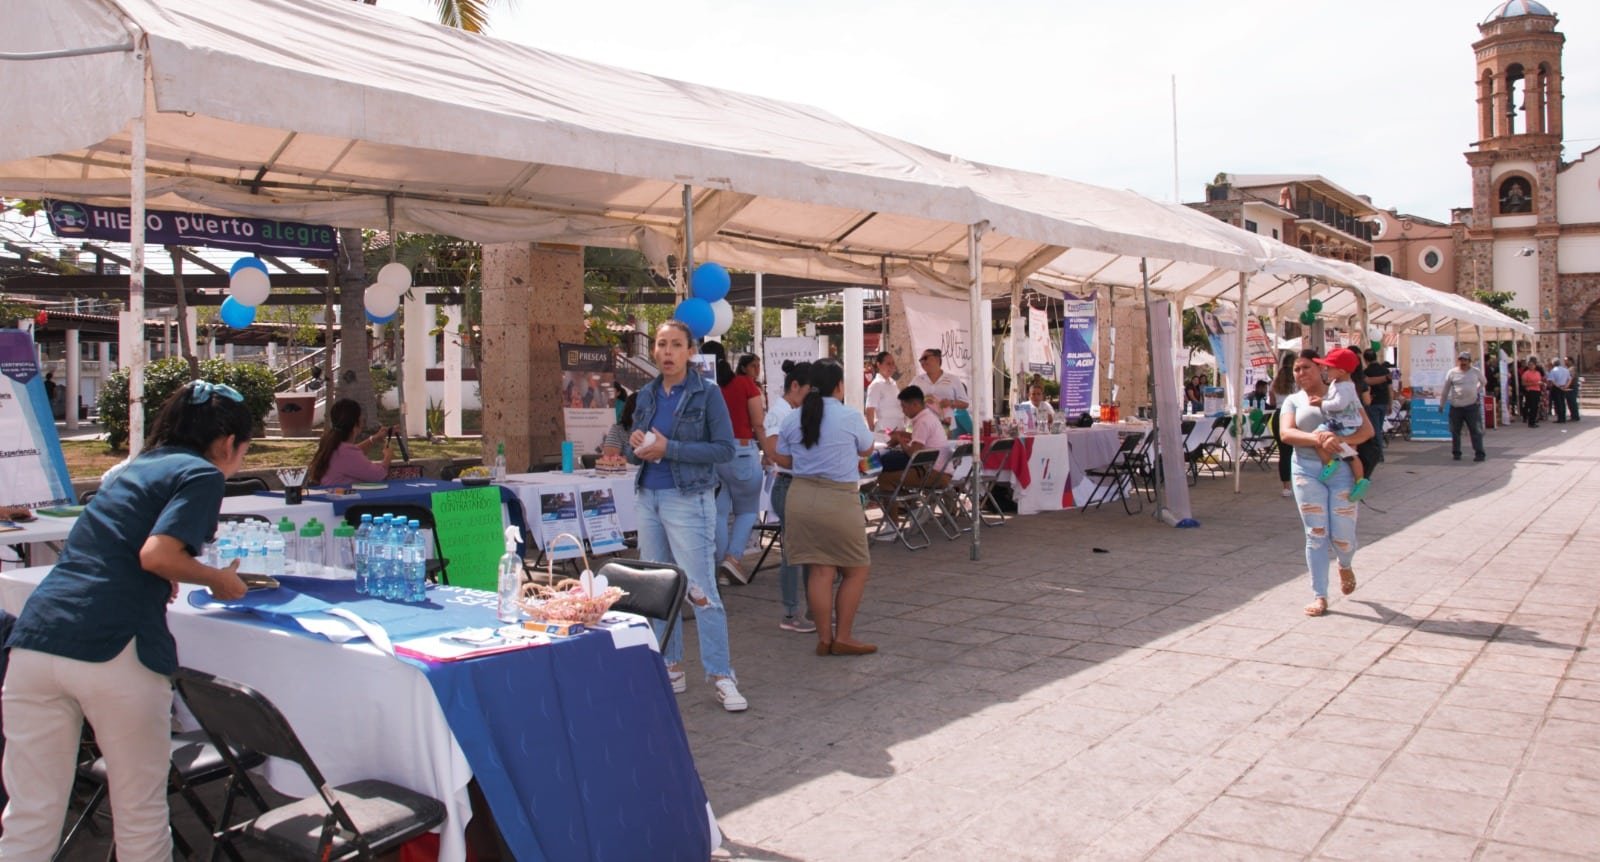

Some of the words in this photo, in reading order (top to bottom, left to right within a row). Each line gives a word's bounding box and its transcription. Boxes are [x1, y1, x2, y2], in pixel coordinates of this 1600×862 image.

[93, 210, 162, 231] HIEO
[175, 215, 254, 236] puerto
[262, 221, 331, 246] alegre
[579, 352, 607, 361] PRESEAS
